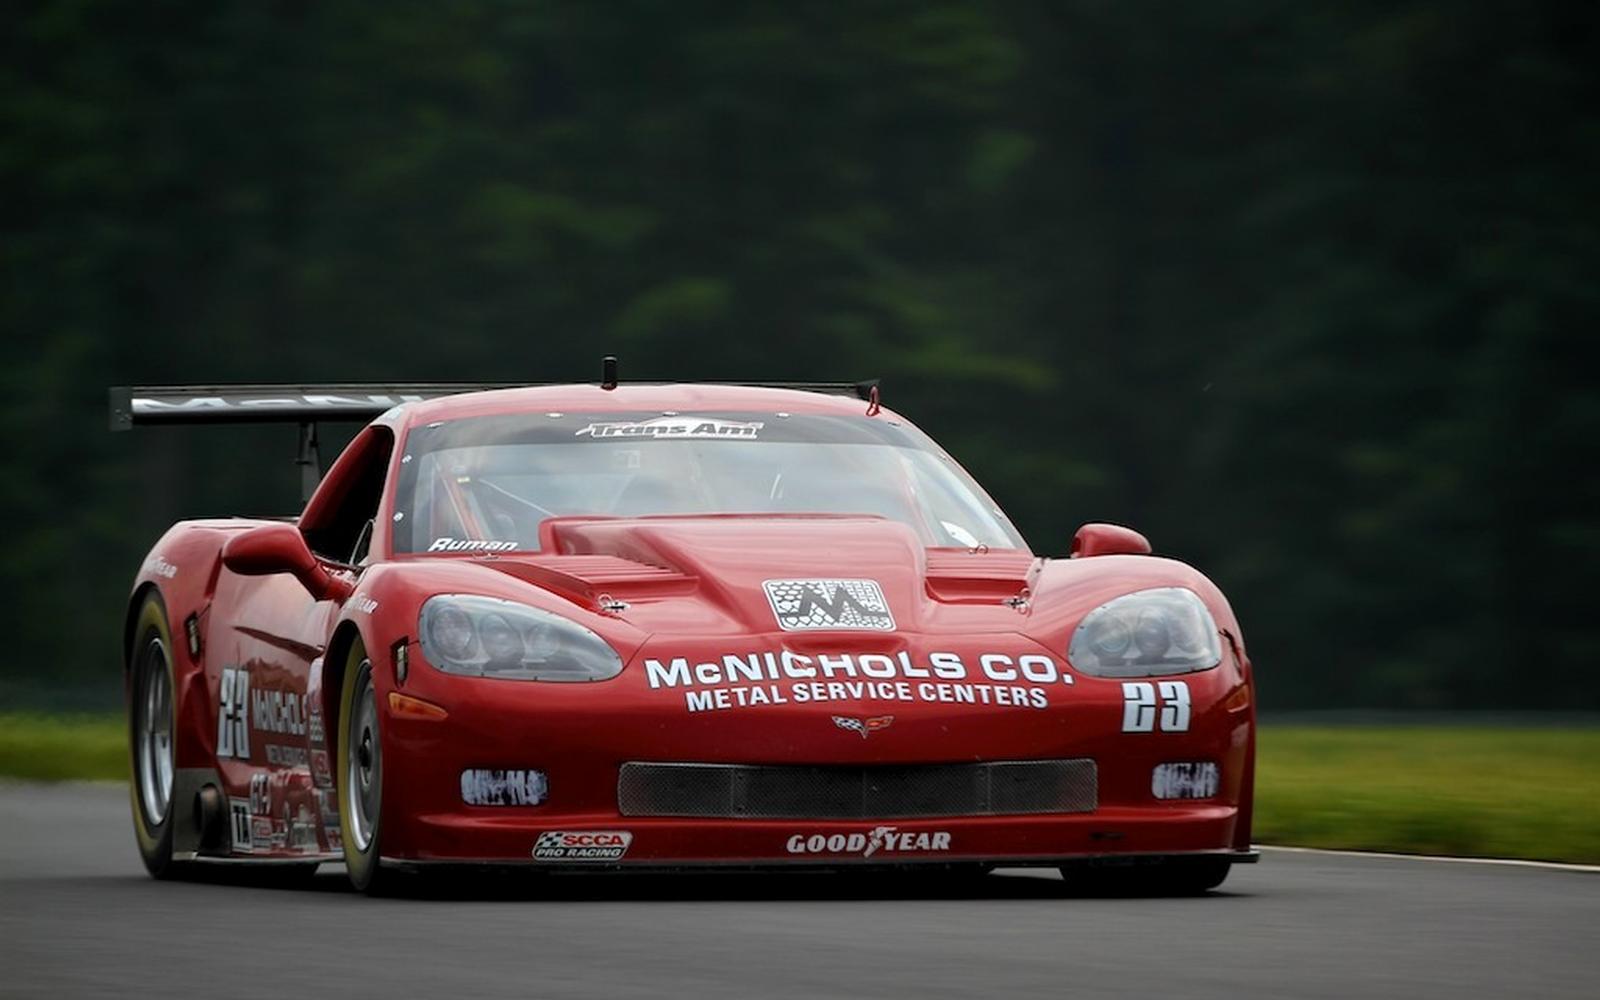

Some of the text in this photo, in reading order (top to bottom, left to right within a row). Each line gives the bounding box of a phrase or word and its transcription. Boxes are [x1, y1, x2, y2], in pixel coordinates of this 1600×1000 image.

[591, 421, 758, 438] Trans Am
[427, 537, 519, 552] Ruman
[644, 650, 1075, 689] McNICHOLS CO.
[686, 681, 1048, 713] METAL SERVICE CENTERS
[1121, 680, 1191, 733] 23
[216, 667, 250, 759] 23
[563, 834, 625, 846] SCCA
[536, 848, 622, 858] PRO RACING
